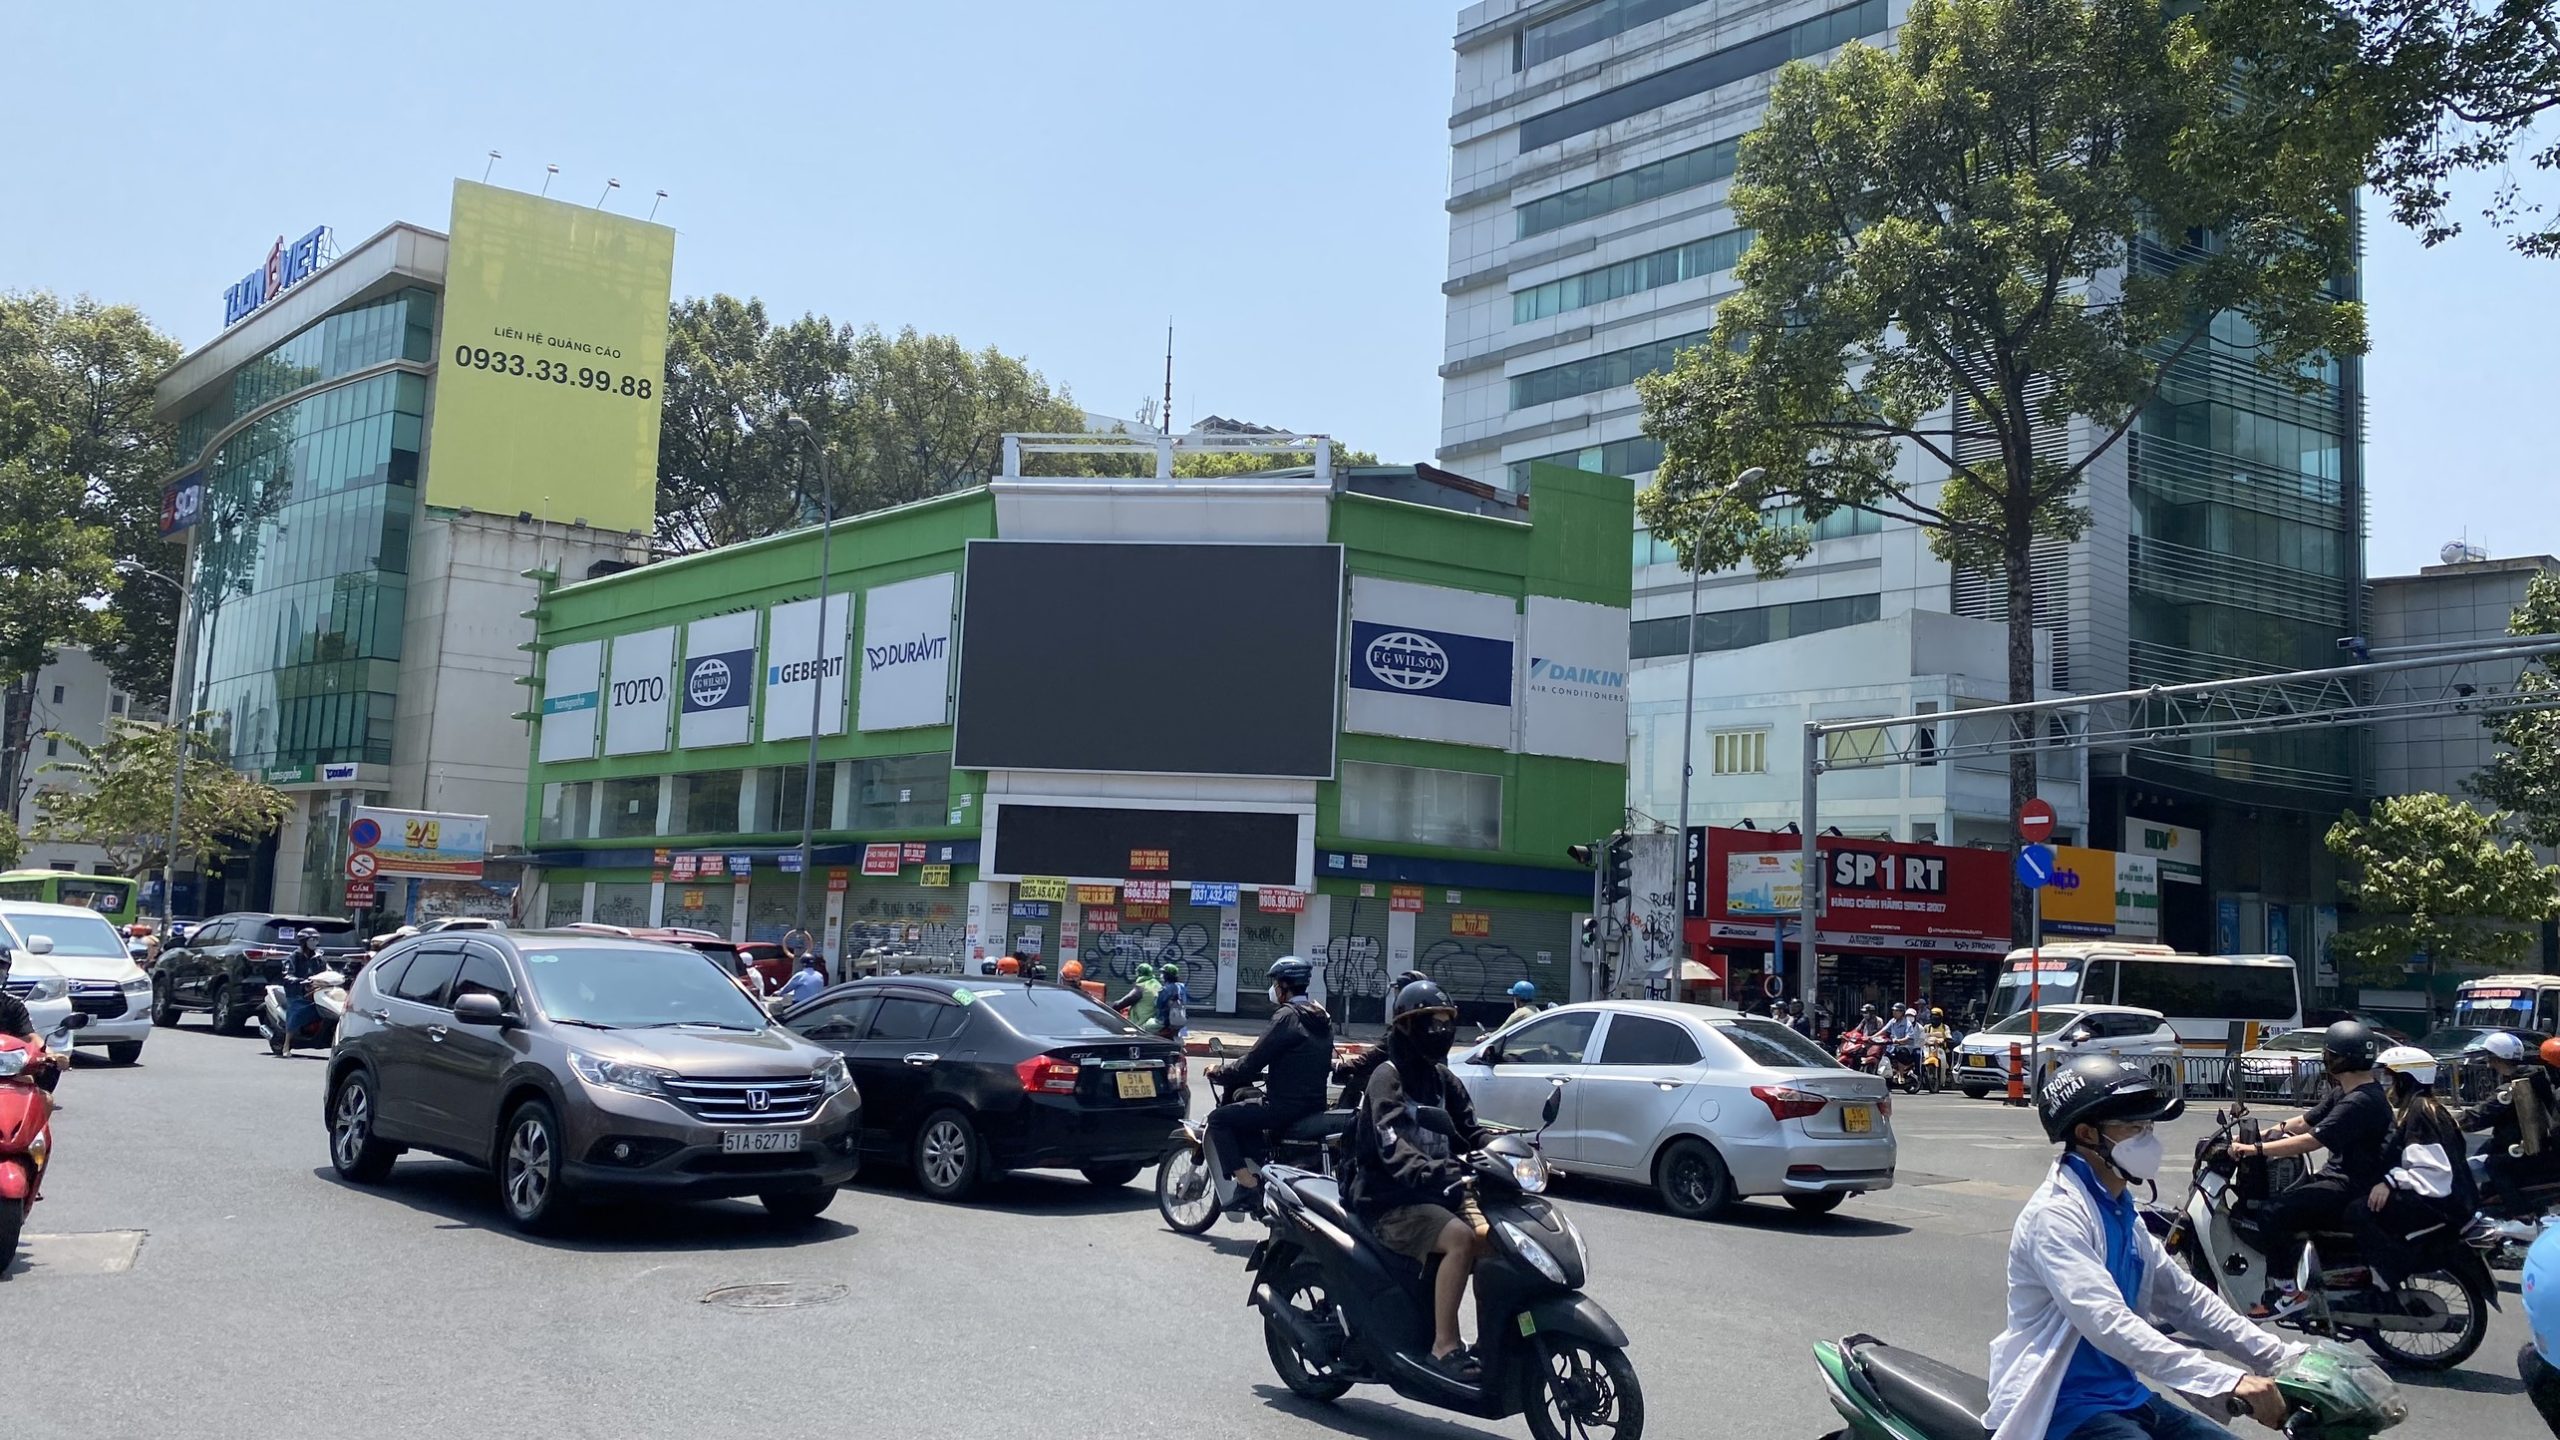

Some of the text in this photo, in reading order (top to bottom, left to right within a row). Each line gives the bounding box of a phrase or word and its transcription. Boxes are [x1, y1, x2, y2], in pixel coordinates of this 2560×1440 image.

[494, 326, 523, 340] LIÊN
[526, 332, 543, 347] HỆ
[594, 346, 621, 359] CÁO
[455, 345, 652, 400] 0933.33.99.88
[888, 632, 947, 666] DURAVIT
[1394, 653, 1443, 670] WILSON
[702, 676, 727, 688] WILSON
[1549, 664, 1624, 688] DAIKIN
[613, 676, 664, 707] TOTO
[1530, 684, 1624, 702] AIR CONDITIONERS
[1904, 901, 1926, 912] SINCE
[1926, 903, 1947, 913] 2007
